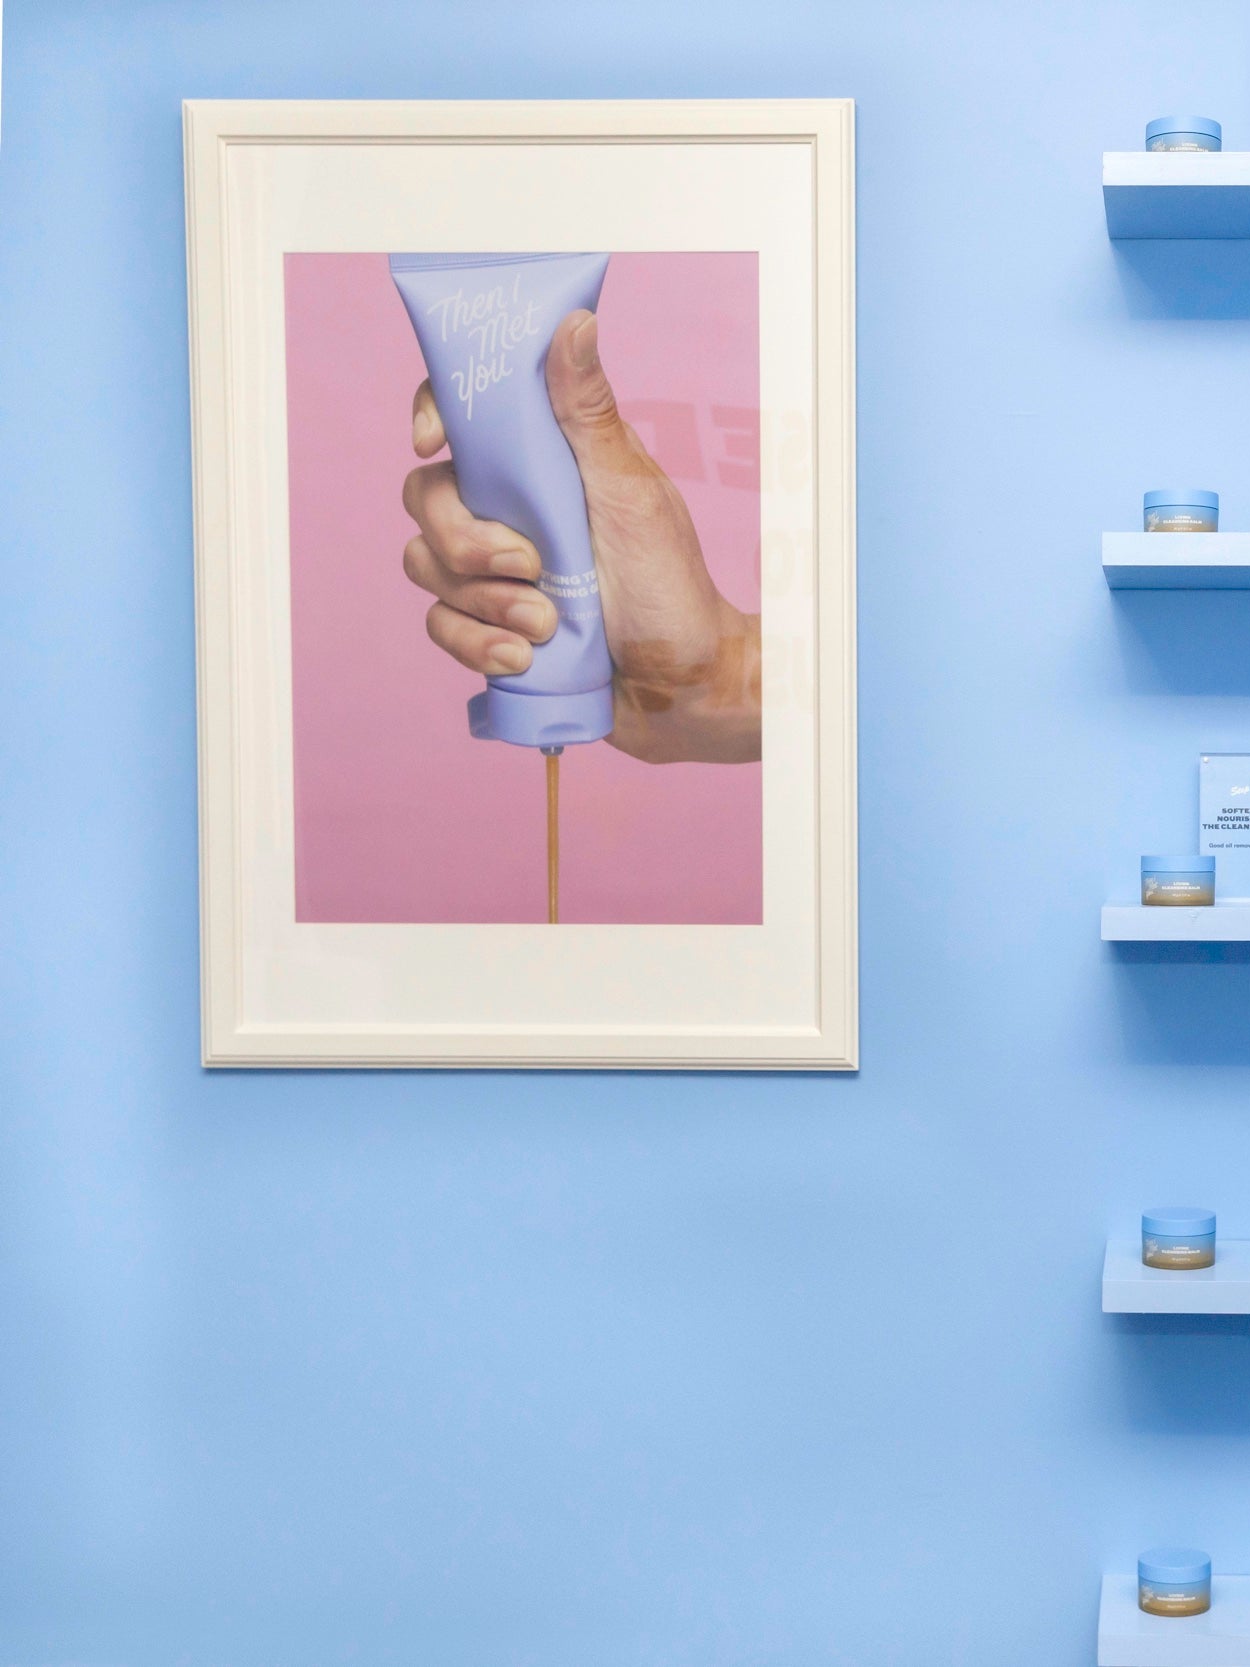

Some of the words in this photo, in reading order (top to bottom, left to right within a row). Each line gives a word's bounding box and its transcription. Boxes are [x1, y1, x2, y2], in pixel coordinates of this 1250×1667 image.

[427, 287, 507, 343] Then
[512, 271, 521, 305] I
[468, 300, 542, 361] Met
[451, 352, 513, 421] You
[1231, 786, 1250, 797] Step
